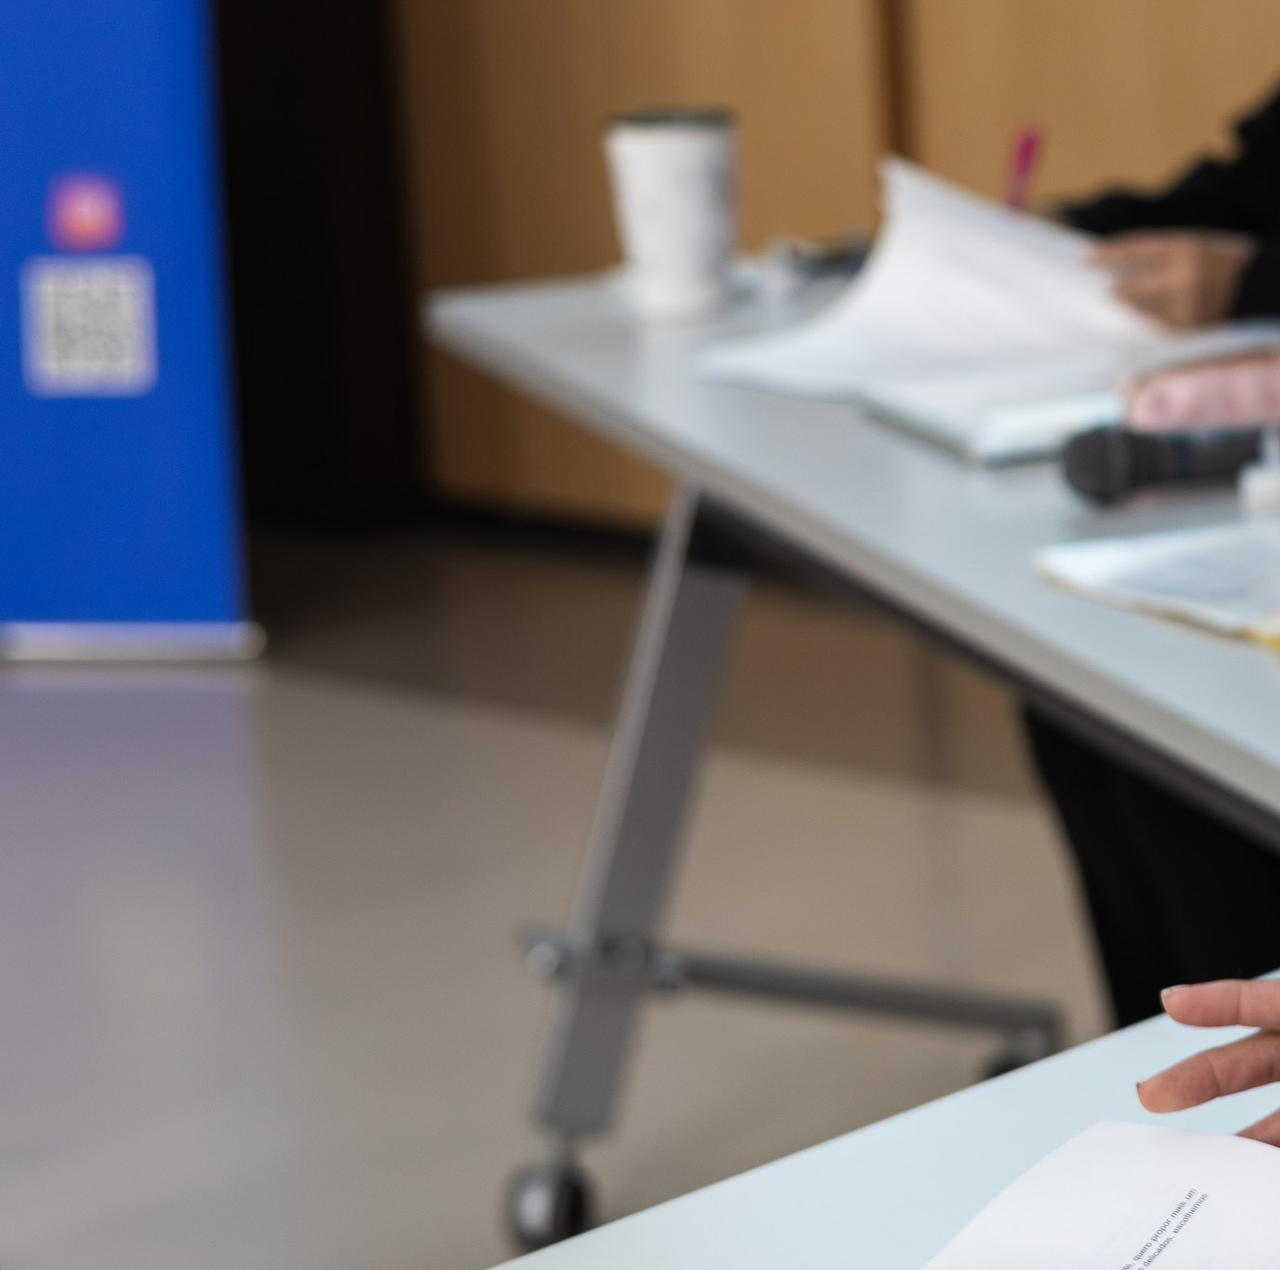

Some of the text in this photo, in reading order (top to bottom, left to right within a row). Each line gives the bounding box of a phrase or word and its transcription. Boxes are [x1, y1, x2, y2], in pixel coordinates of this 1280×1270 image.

[1133, 1242, 1152, 1261] quero
[1150, 1218, 1171, 1242] propor
[1170, 1201, 1187, 1218] mais
[1184, 1188, 1197, 1200] um
[1143, 1237, 1173, 1267] delicados,
[1173, 1194, 1208, 1234] escolhemos
